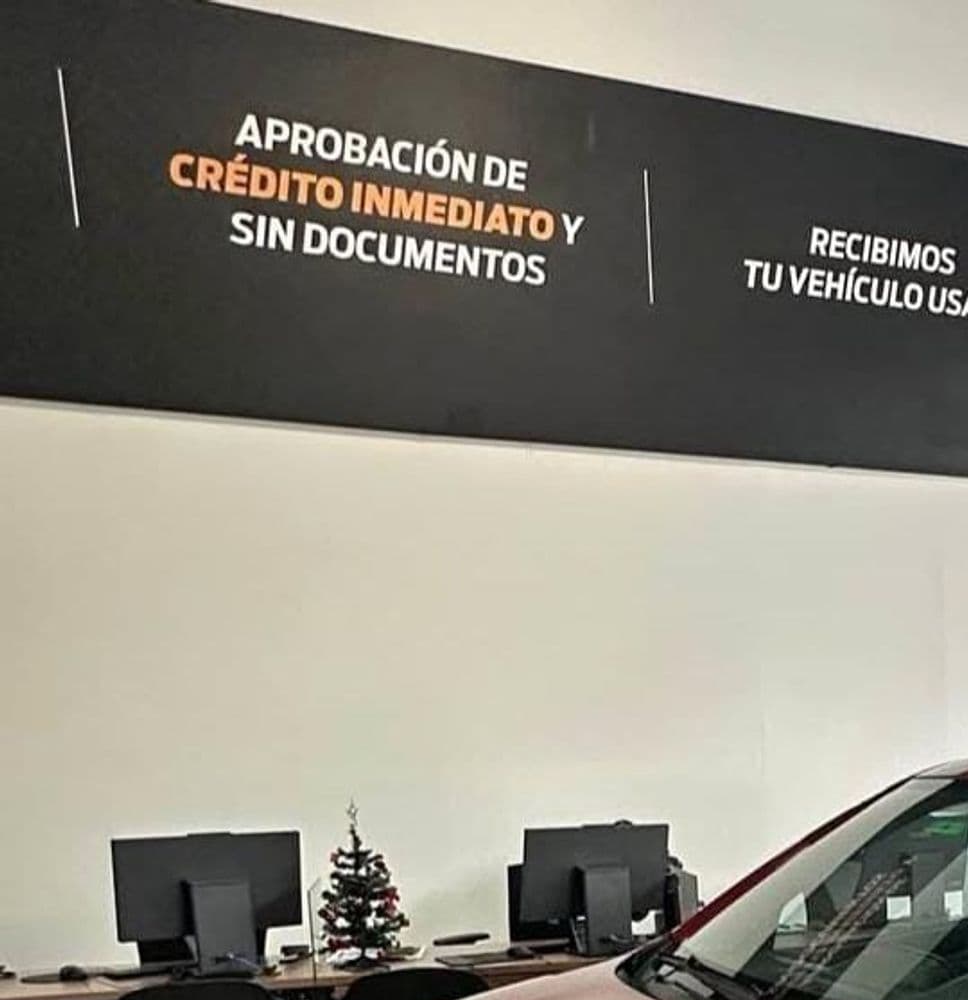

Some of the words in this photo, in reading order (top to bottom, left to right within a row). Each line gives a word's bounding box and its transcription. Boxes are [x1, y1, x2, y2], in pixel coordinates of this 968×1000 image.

[234, 113, 477, 184] APROBACIÓN
[482, 154, 528, 192] DE
[169, 152, 344, 210] CRÉDITO
[350, 180, 555, 241] INMEDIATO
[561, 213, 585, 245] Y
[229, 211, 295, 252] SIN
[302, 221, 546, 286] DOCUMENTOS
[743, 259, 784, 292] TU
[789, 266, 924, 310] VEHÍCULO
[809, 226, 956, 275] RECIBIMOS
